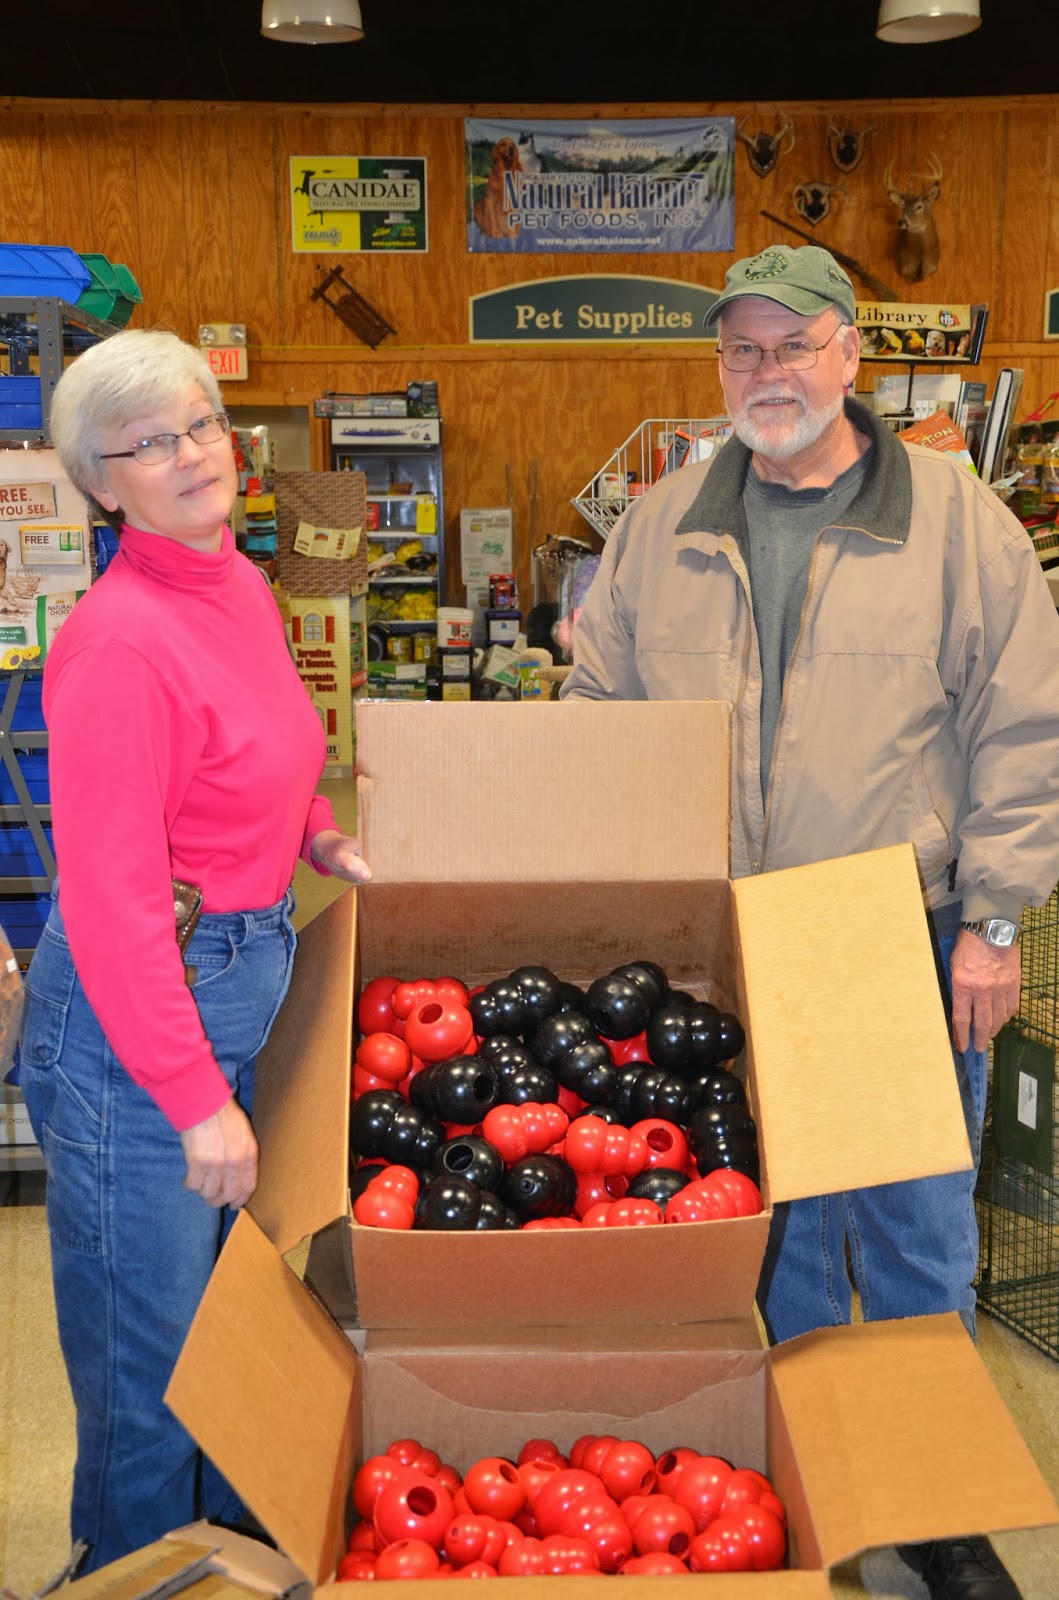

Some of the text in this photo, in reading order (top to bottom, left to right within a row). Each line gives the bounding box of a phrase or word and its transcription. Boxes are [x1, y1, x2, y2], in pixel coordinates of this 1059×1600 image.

[311, 181, 415, 199] CANIDAE
[503, 170, 708, 211] Natural Balanc
[312, 200, 344, 208] NATURAL
[508, 211, 701, 230] PET FOODS, INC.
[536, 235, 661, 246] www.naturalbalance.net
[515, 303, 693, 334] Pet Supplies
[855, 306, 928, 327] Library
[208, 350, 241, 375] EXIT
[0, 504, 49, 516] YOU SEE.
[24, 535, 49, 545] FREE
[48, 603, 73, 611] NATURAL
[50, 608, 70, 616] CHOICE
[296, 648, 332, 658] Termites
[305, 658, 337, 668] Houses.
[315, 682, 337, 693] Now!
